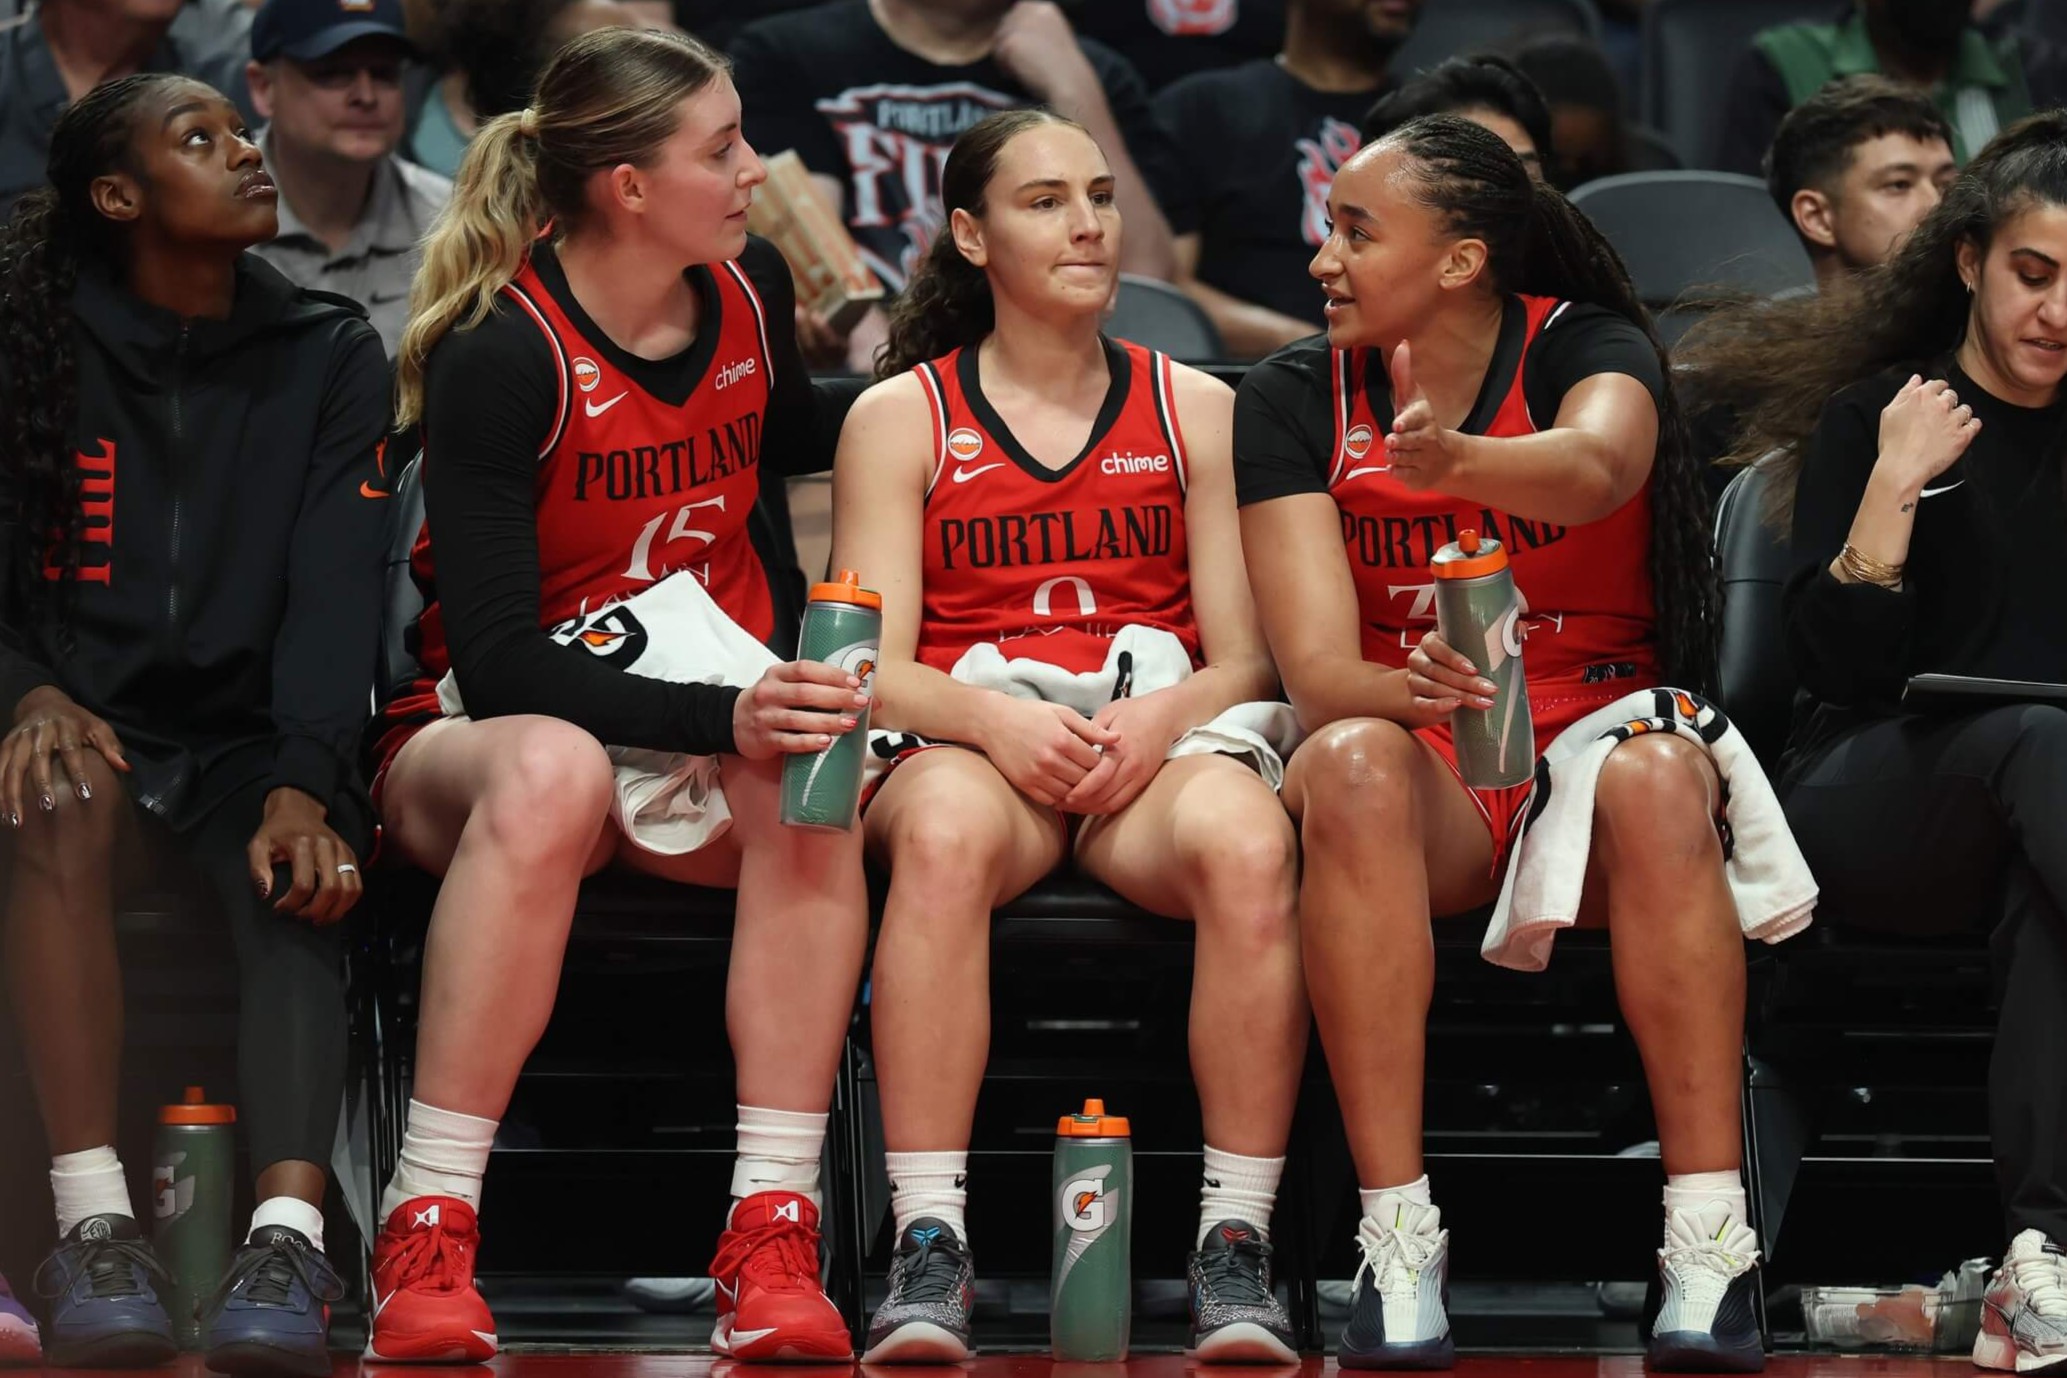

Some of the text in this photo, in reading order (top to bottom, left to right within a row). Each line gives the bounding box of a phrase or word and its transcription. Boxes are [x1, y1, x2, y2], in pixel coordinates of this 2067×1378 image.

[876, 99, 986, 138] PORTLA
[714, 357, 756, 391] chime
[573, 410, 760, 502] PORTLAND
[1100, 451, 1169, 475] chime
[939, 504, 1171, 571] PORTLAND
[1062, 1178, 1106, 1232] G
